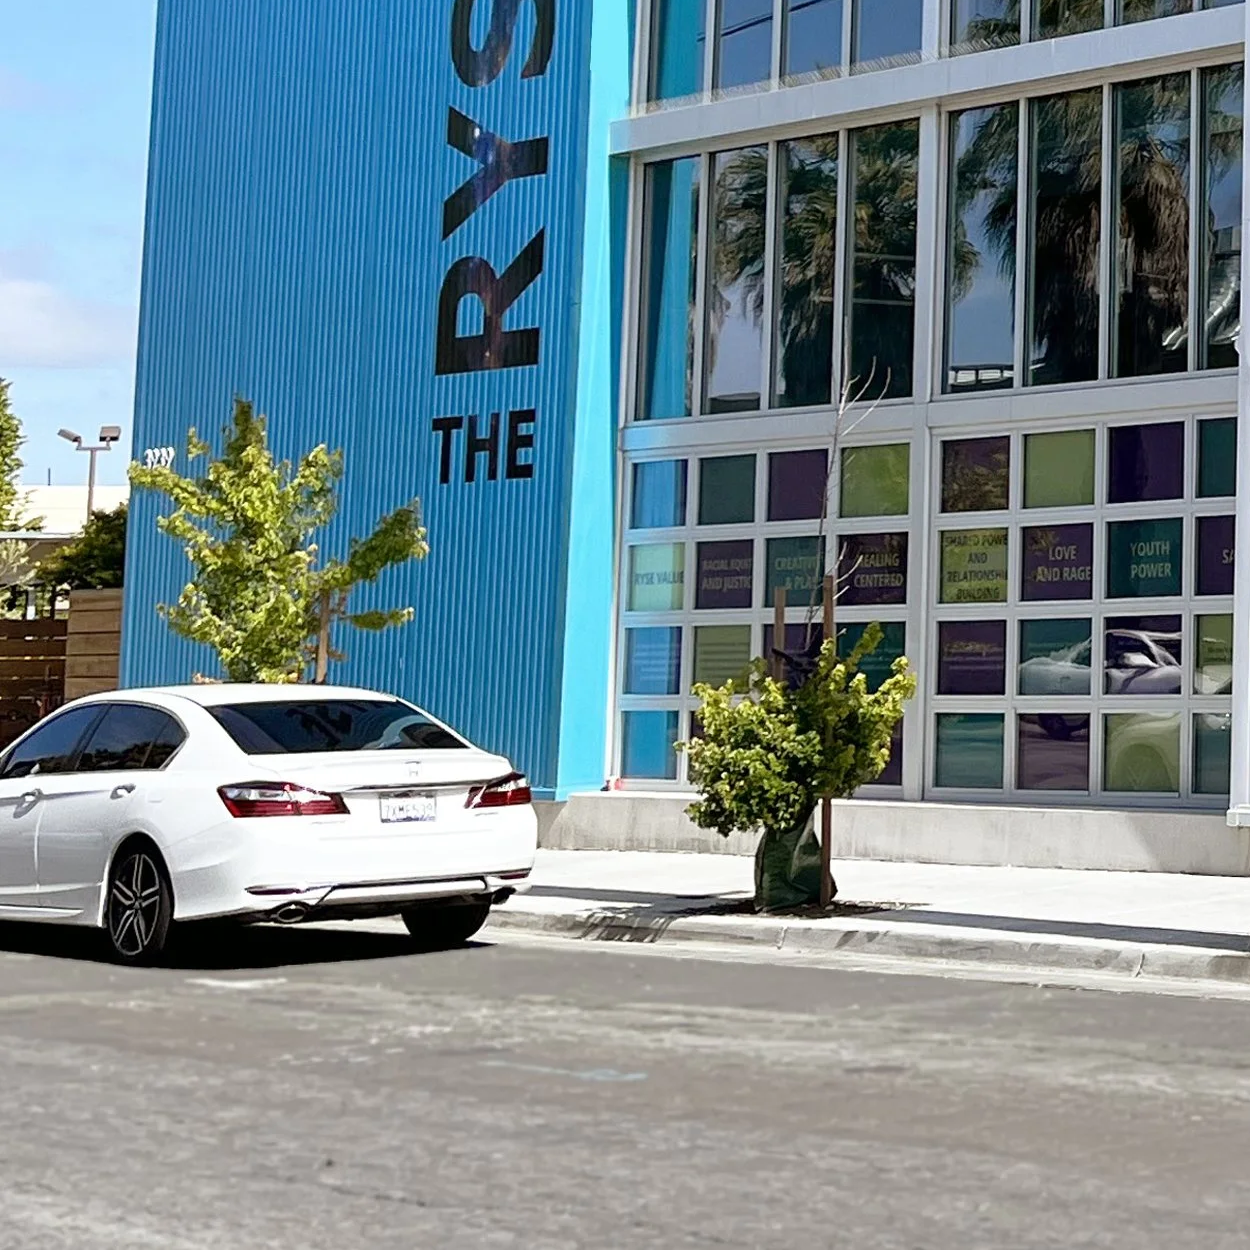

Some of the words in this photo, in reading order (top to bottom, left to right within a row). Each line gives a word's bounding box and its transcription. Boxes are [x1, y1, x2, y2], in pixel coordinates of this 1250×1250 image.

[432, 409, 536, 484] THE
[1049, 545, 1077, 560] LOVE
[1130, 541, 1170, 556] YOUTH
[968, 552, 988, 564] AND
[1036, 566, 1060, 582] AND
[1063, 565, 1091, 581] RAGE
[1131, 563, 1171, 578] POWER
[635, 572, 654, 585] RYSE
[702, 577, 723, 590] AND
[854, 573, 904, 588] CENTERED
